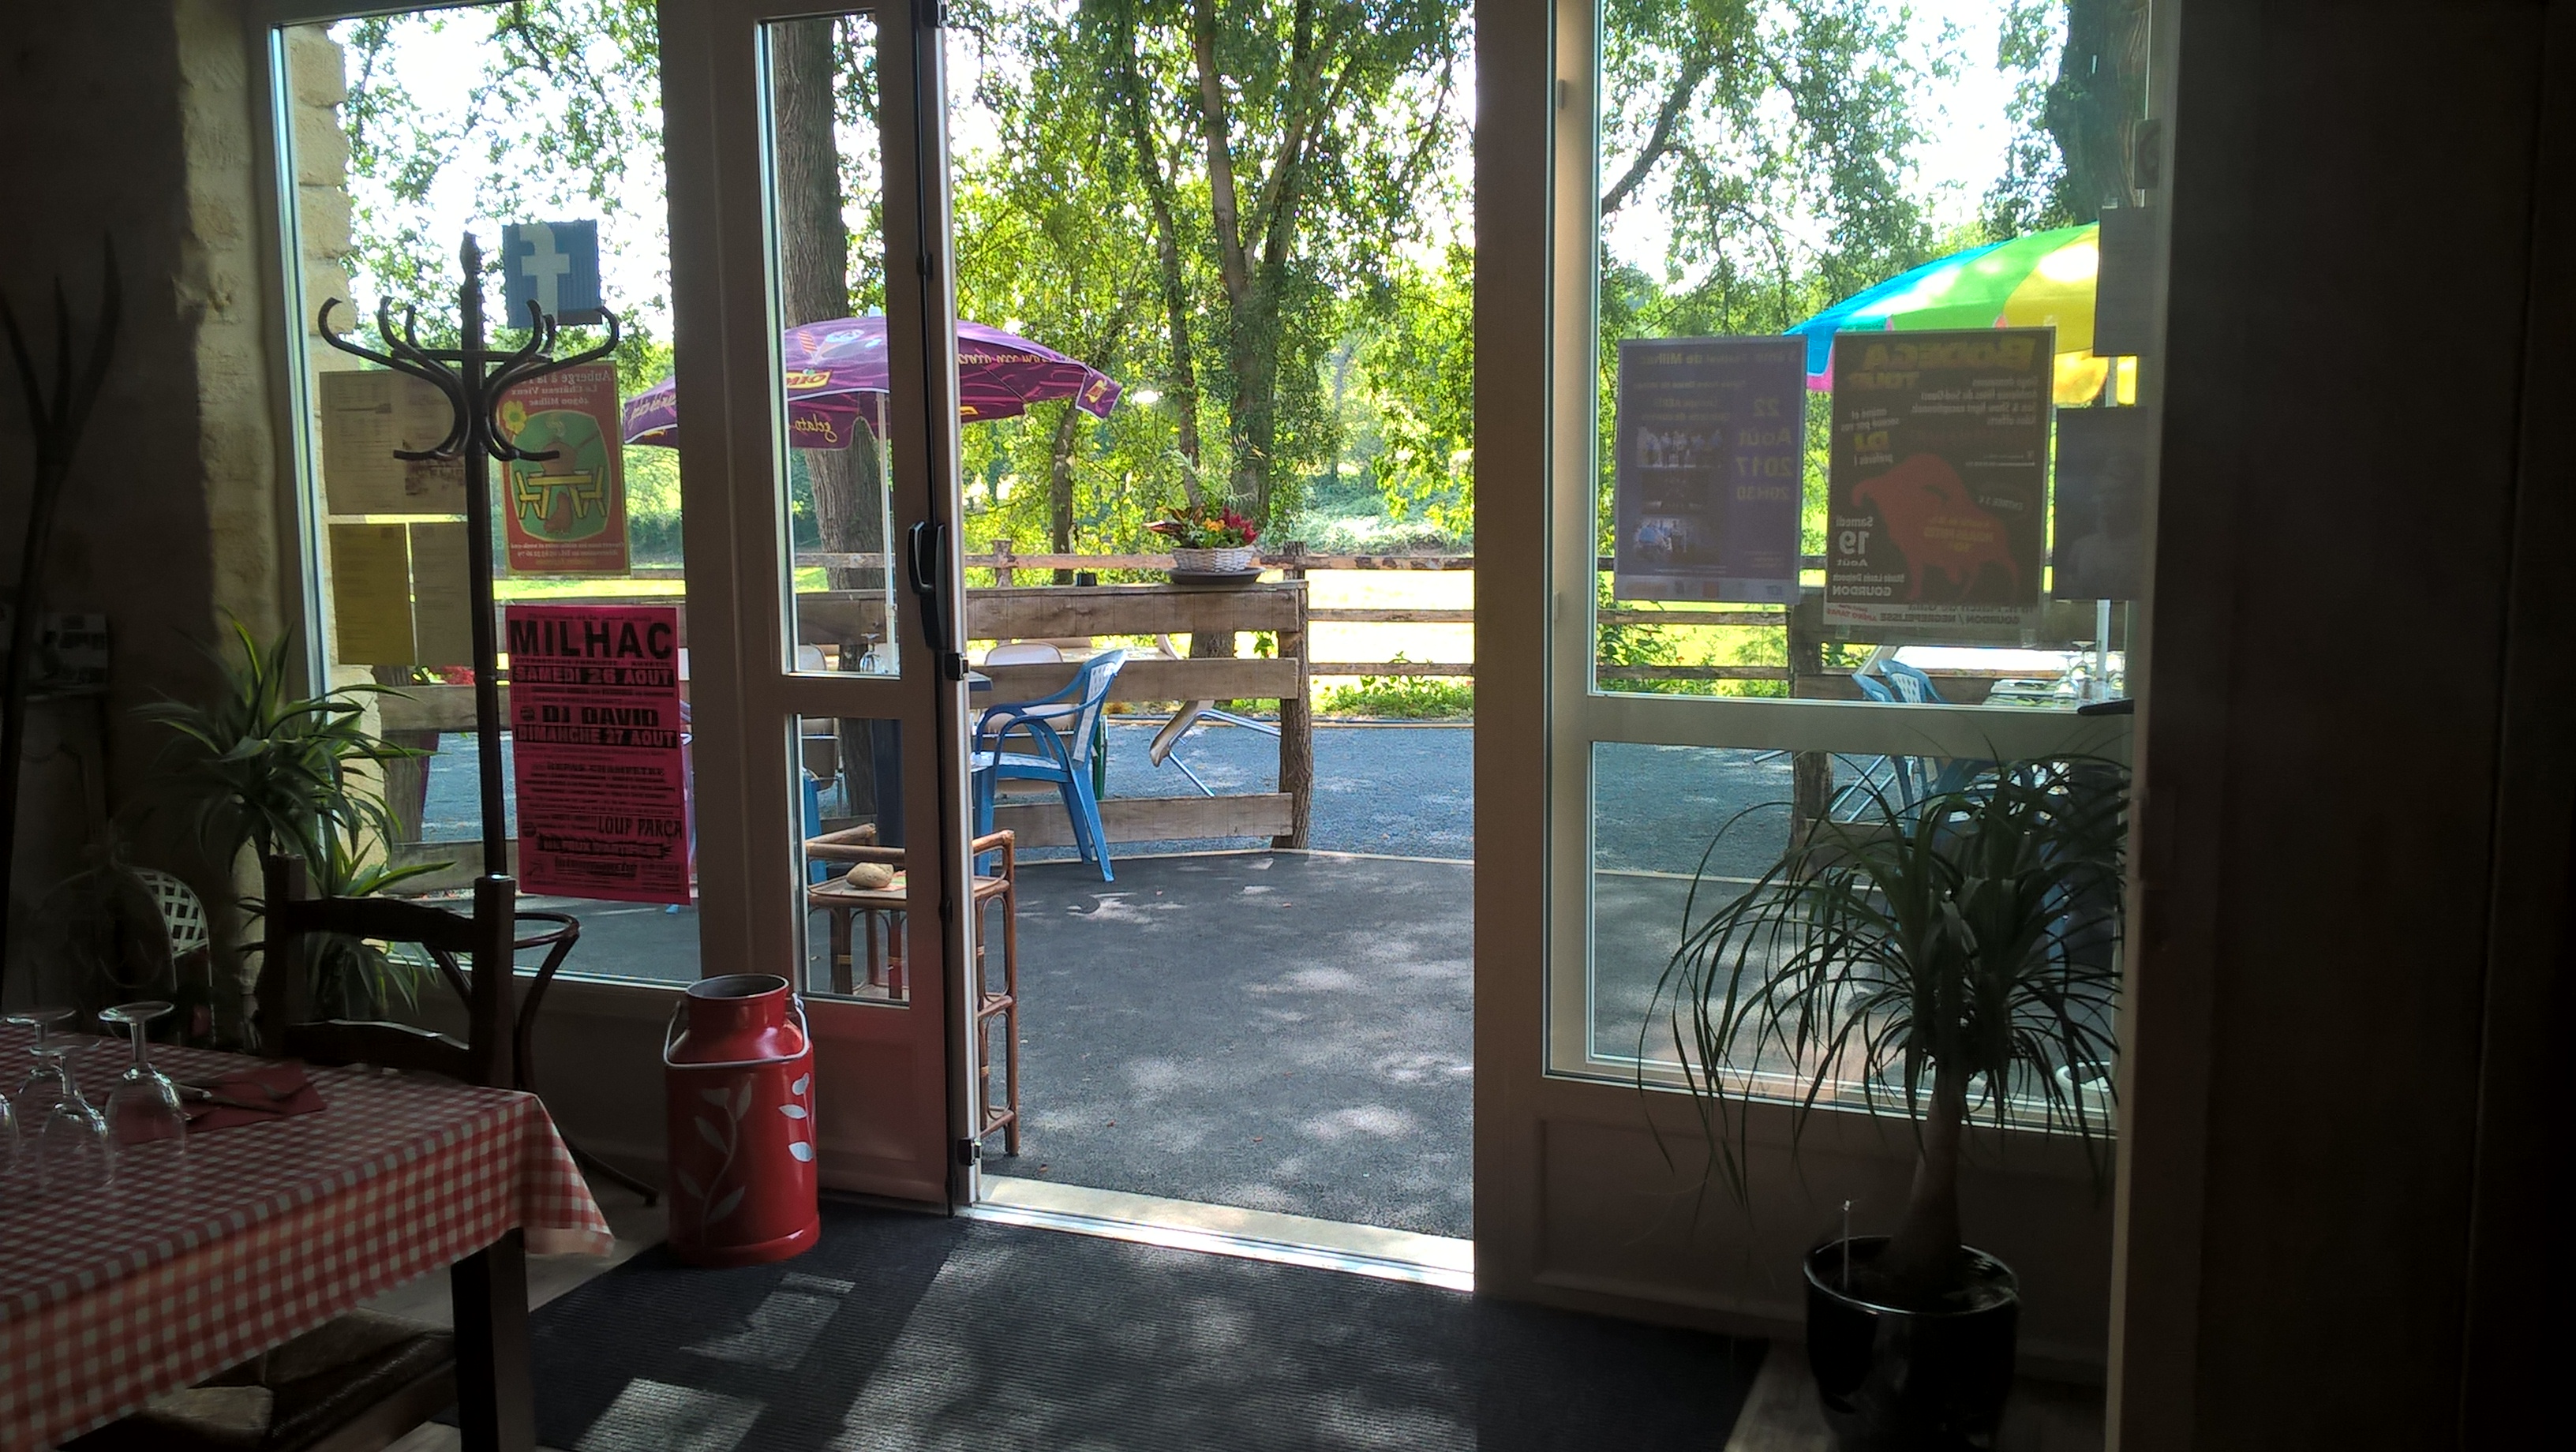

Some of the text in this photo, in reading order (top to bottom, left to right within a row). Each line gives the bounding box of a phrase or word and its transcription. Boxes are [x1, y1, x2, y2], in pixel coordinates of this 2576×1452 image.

[509, 619, 672, 660] MILHAC
[514, 666, 672, 686] SAMEDI 26 AOUT
[581, 706, 658, 727] DAVID
[518, 725, 676, 747] DIMANCHE 27 AOUT
[598, 815, 634, 836] LOUP
